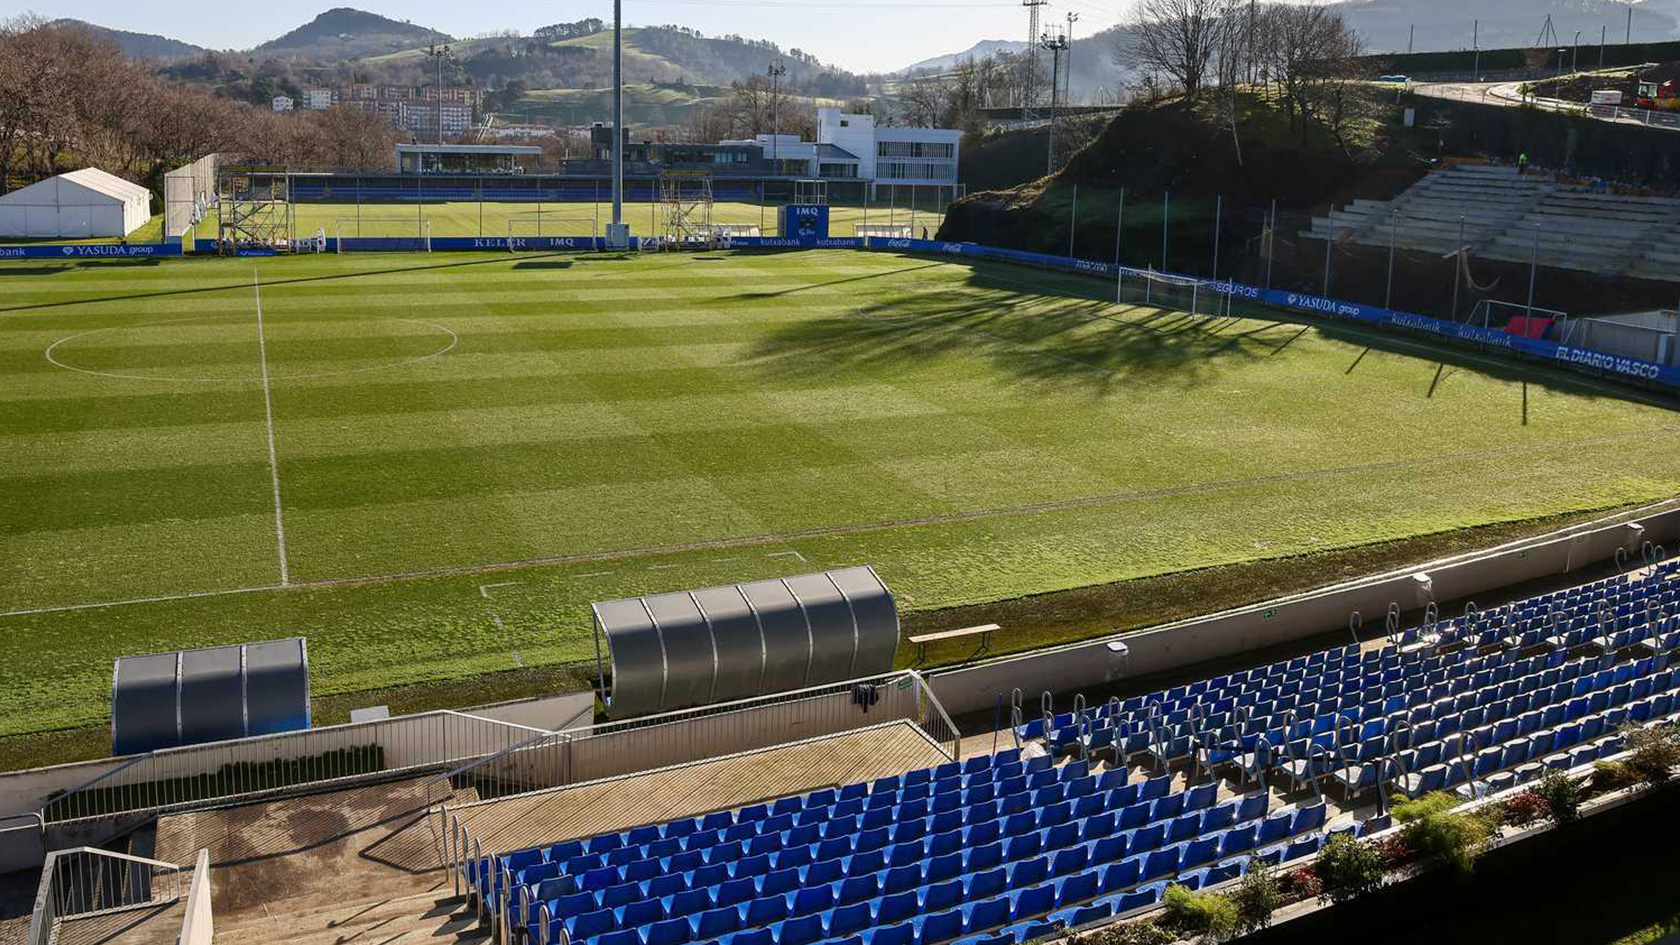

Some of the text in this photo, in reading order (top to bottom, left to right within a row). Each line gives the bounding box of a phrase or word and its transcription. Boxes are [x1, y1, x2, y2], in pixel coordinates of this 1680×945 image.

[796, 207, 819, 216] IMQ
[550, 239, 574, 247] IMQ
[760, 238, 800, 247] kutxabank
[77, 246, 153, 256] YASUDA group
[1210, 282, 1258, 298] SEGUROS
[1299, 295, 1360, 317] YASUDA group
[1391, 312, 1440, 333] kutxabank
[1459, 326, 1512, 347] kutxabank
[1556, 346, 1659, 379] EL DIARIO VASCO
